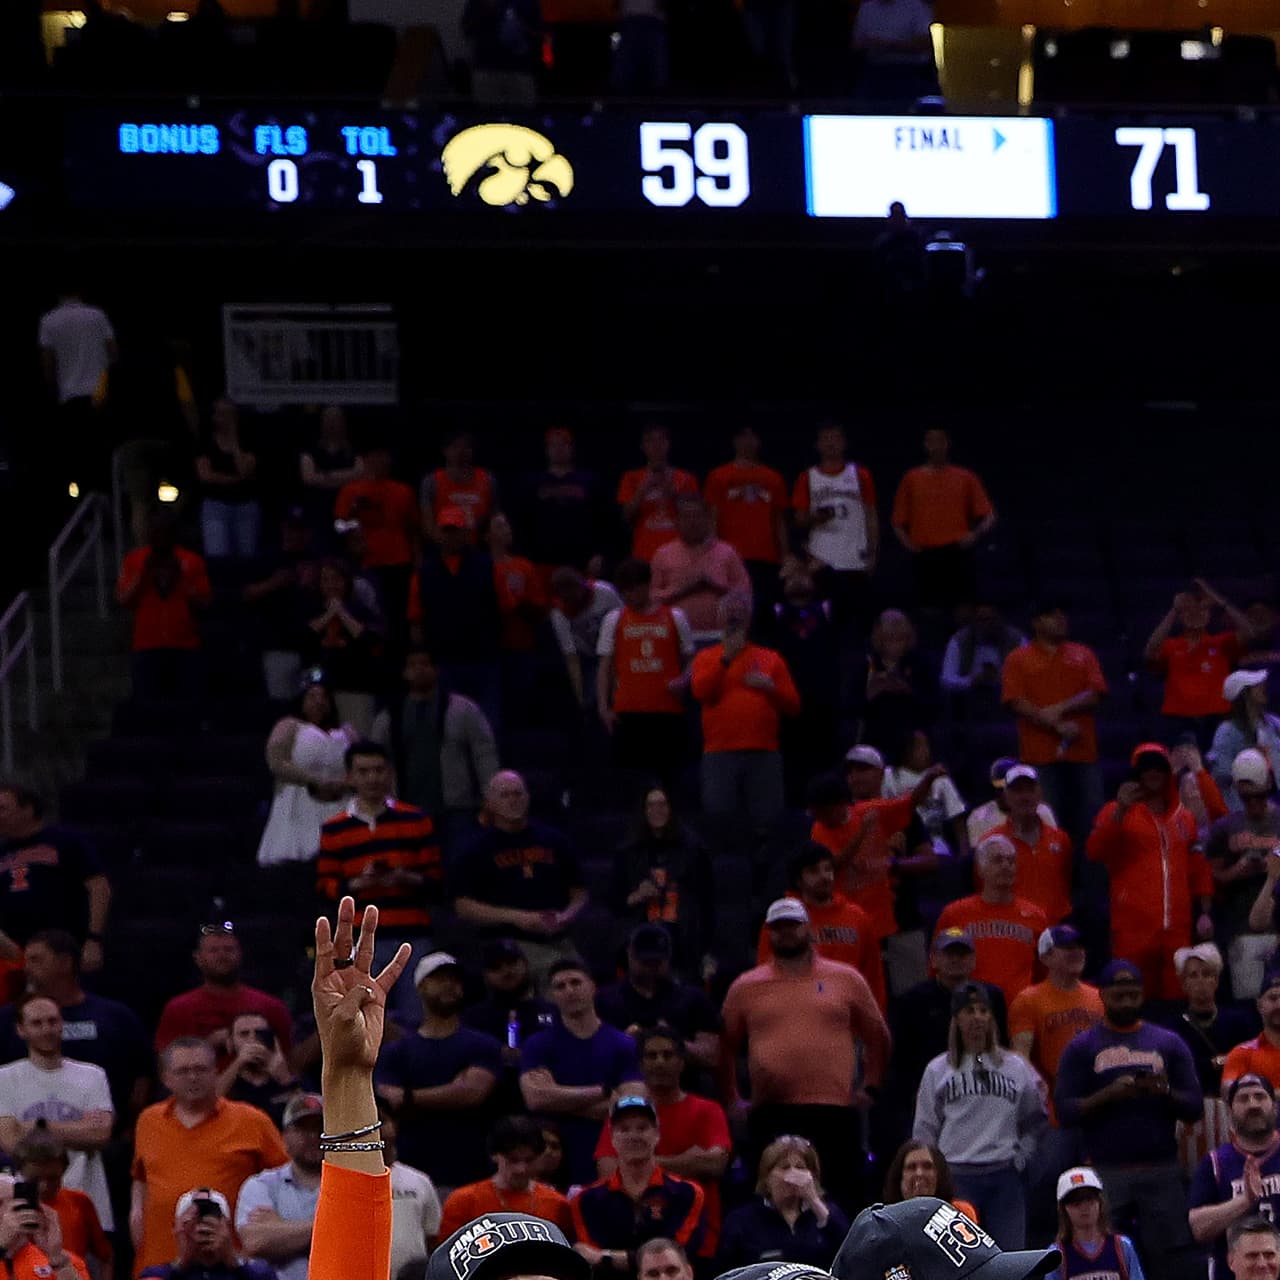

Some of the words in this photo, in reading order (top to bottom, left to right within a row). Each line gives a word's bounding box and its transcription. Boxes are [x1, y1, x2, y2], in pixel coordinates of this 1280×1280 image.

[119, 124, 219, 154] BONUS
[255, 124, 307, 155] FLS
[341, 126, 396, 156] TOL
[895, 127, 963, 150] FINAL
[267, 159, 299, 202] 0
[357, 160, 383, 203] 1
[640, 122, 750, 207] 59
[1115, 127, 1210, 210] 71
[450, 1219, 496, 1262] FINAL
[923, 1204, 958, 1240] FINAL
